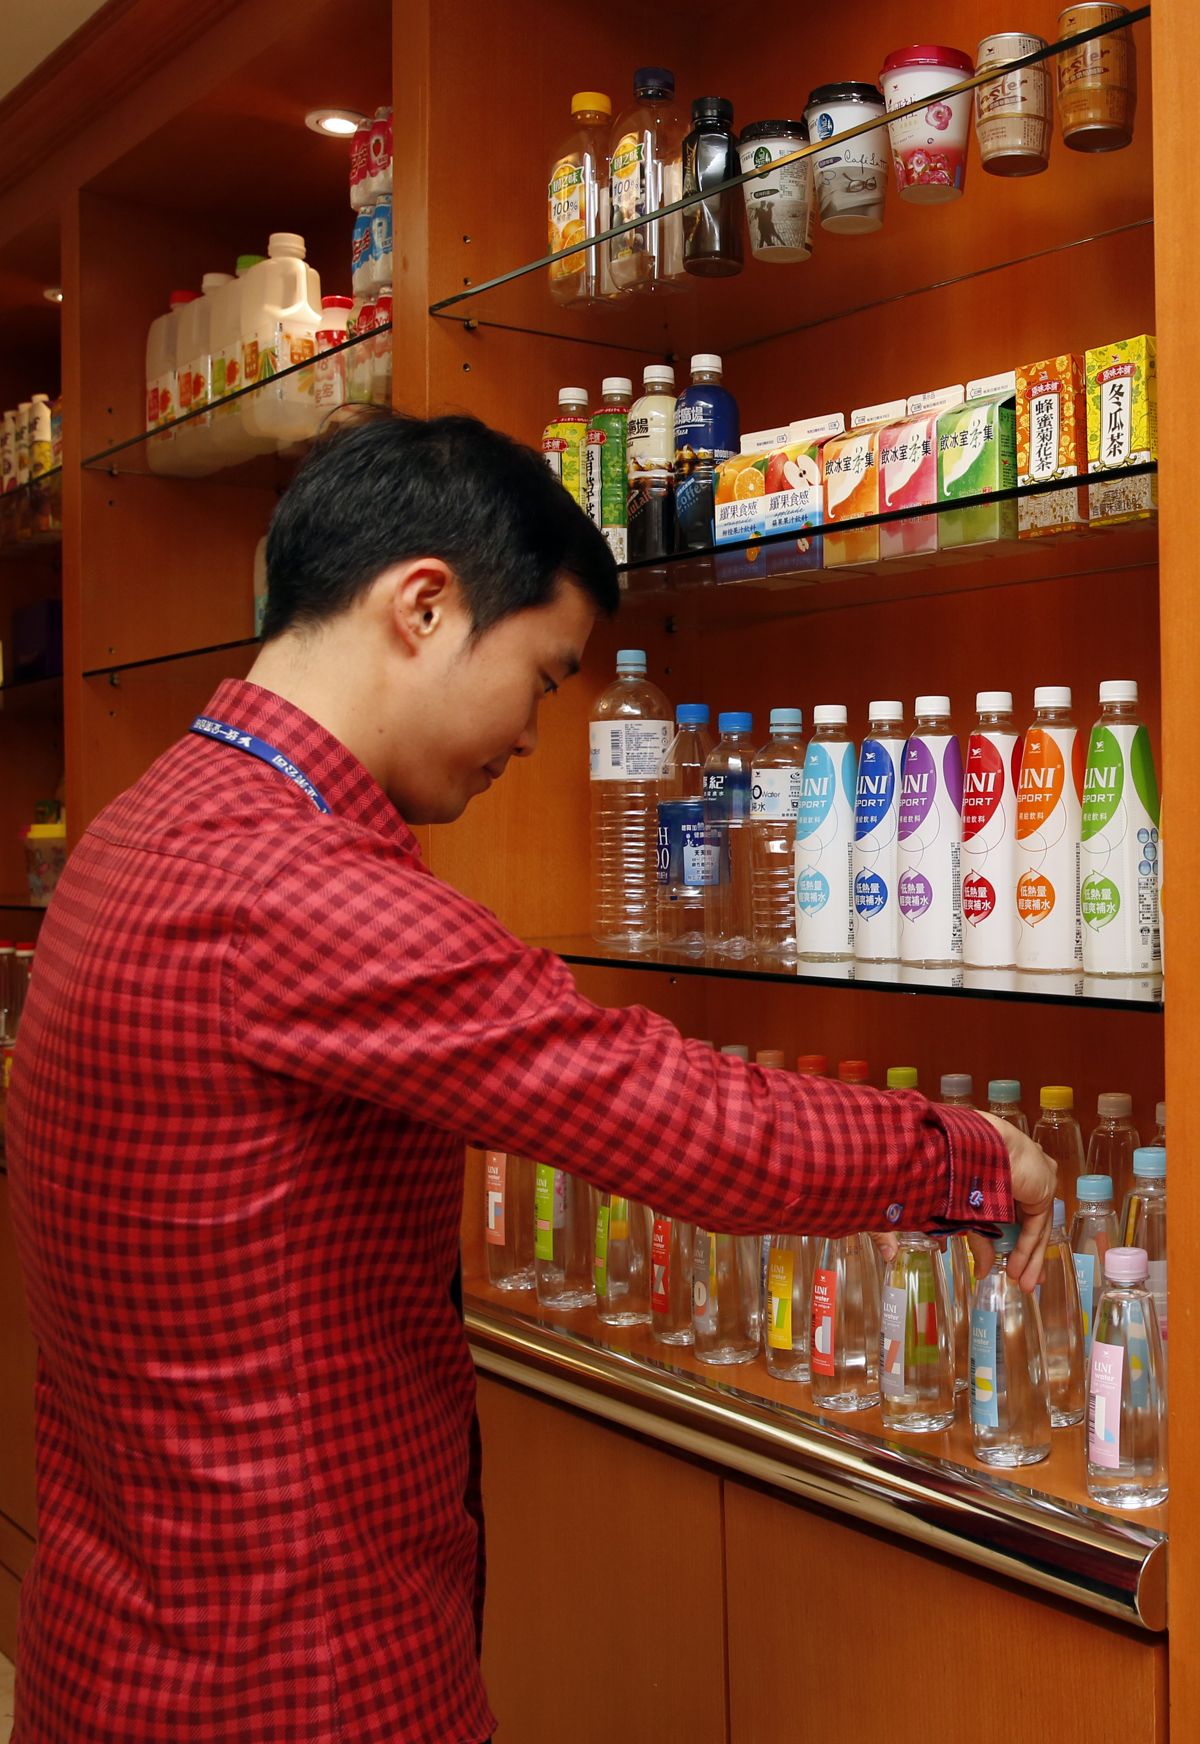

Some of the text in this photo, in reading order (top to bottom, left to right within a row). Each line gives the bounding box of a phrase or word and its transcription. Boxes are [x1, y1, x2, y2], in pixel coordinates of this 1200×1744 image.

[553, 200, 579, 216] 100%
[1102, 364, 1132, 381] 原味本舖
[1106, 382, 1126, 458] 冬瓜茶
[939, 418, 994, 452] 飲冰室茶集
[1035, 398, 1055, 473] 蜂蜜菊花茶
[880, 433, 932, 465] 飲冰室茶集
[825, 446, 875, 477] 飲冰室茶集
[770, 489, 810, 512] 纖果食感
[719, 501, 759, 521] 纖果食感
[801, 880, 822, 891] 低熱量
[857, 882, 880, 895] 低熱量
[901, 882, 925, 895] 低熱量
[964, 886, 988, 899] 低熱量
[1020, 885, 1048, 898] 低熱量
[1085, 888, 1113, 901] 低熱量
[814, 1295, 830, 1303] water
[1095, 1372, 1115, 1382] water
